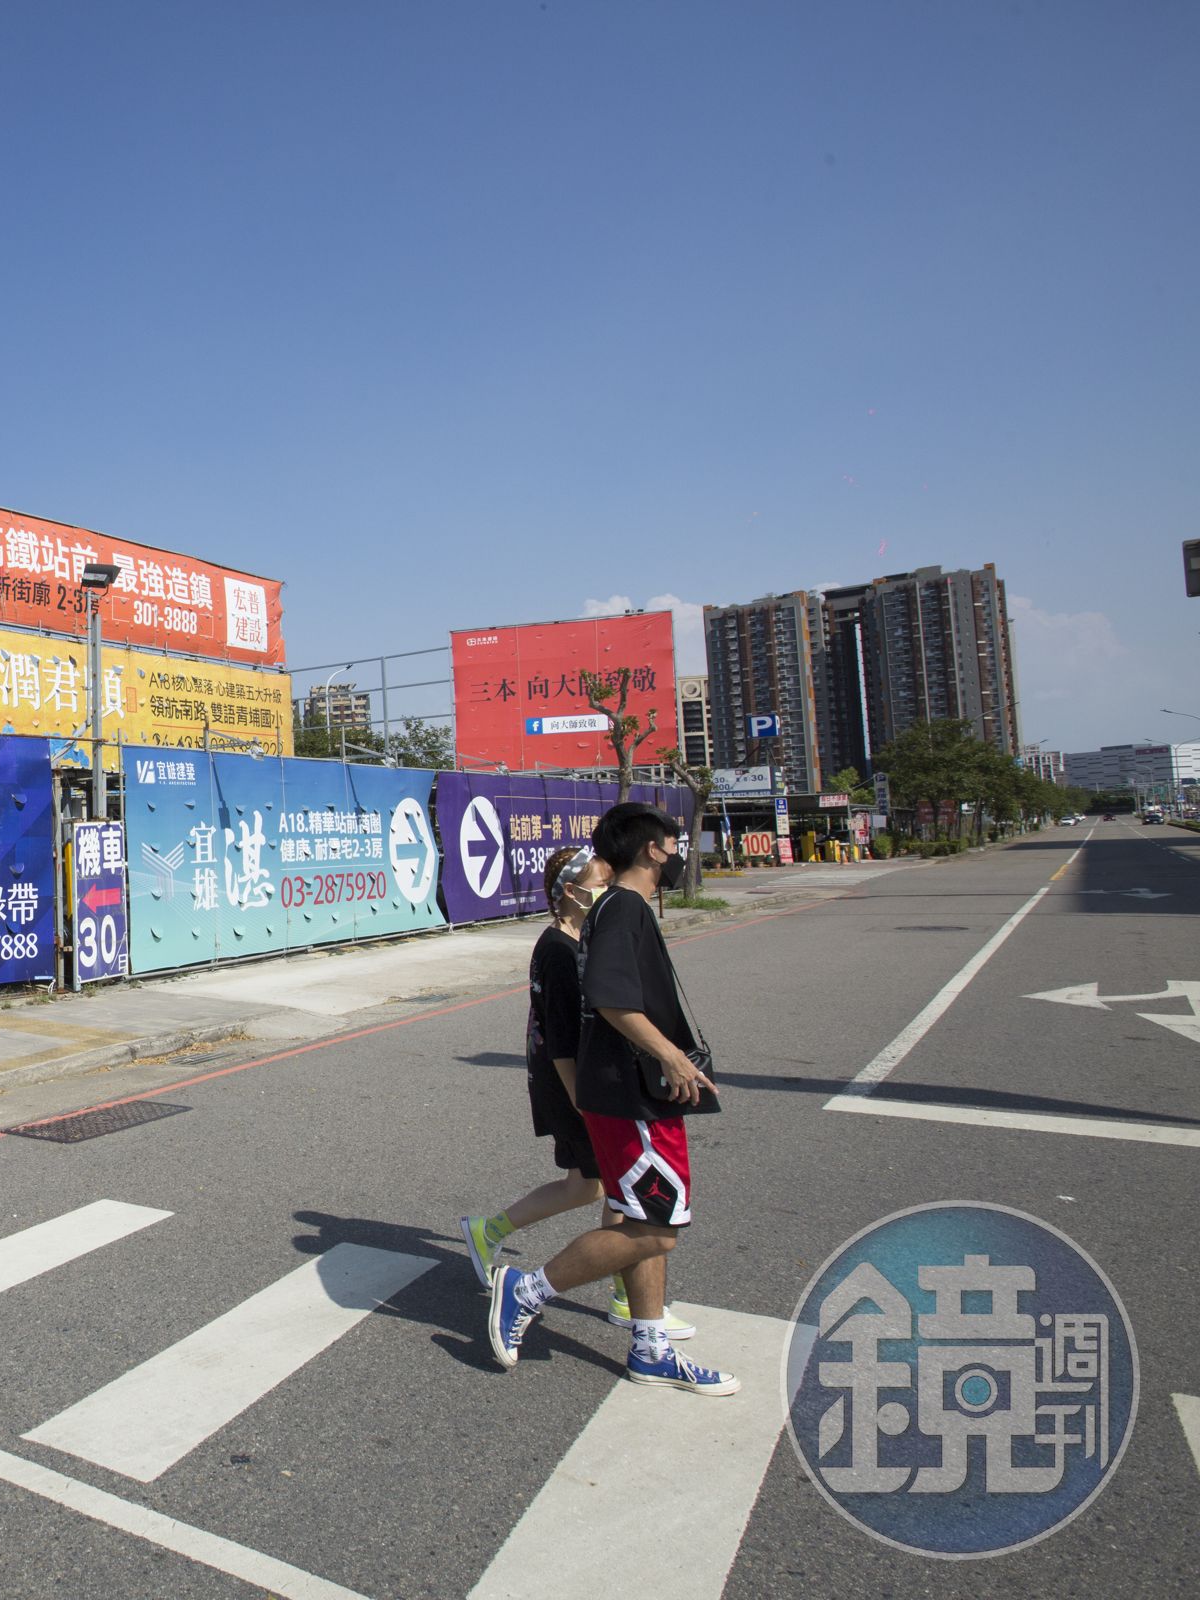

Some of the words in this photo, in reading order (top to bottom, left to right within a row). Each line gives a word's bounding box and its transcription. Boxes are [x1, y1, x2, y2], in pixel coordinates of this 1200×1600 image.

[112, 552, 213, 611] 最強造鎮
[233, 586, 260, 615] 宏普
[133, 600, 197, 635] 301-3888
[235, 616, 261, 644] 建設
[470, 678, 516, 703] 三本
[751, 714, 774, 738] P
[510, 814, 562, 840] 站前第一排
[78, 827, 121, 877] 機車
[743, 832, 772, 856] 100
[189, 821, 218, 911] 宜雄
[280, 871, 387, 909] 03-2875920
